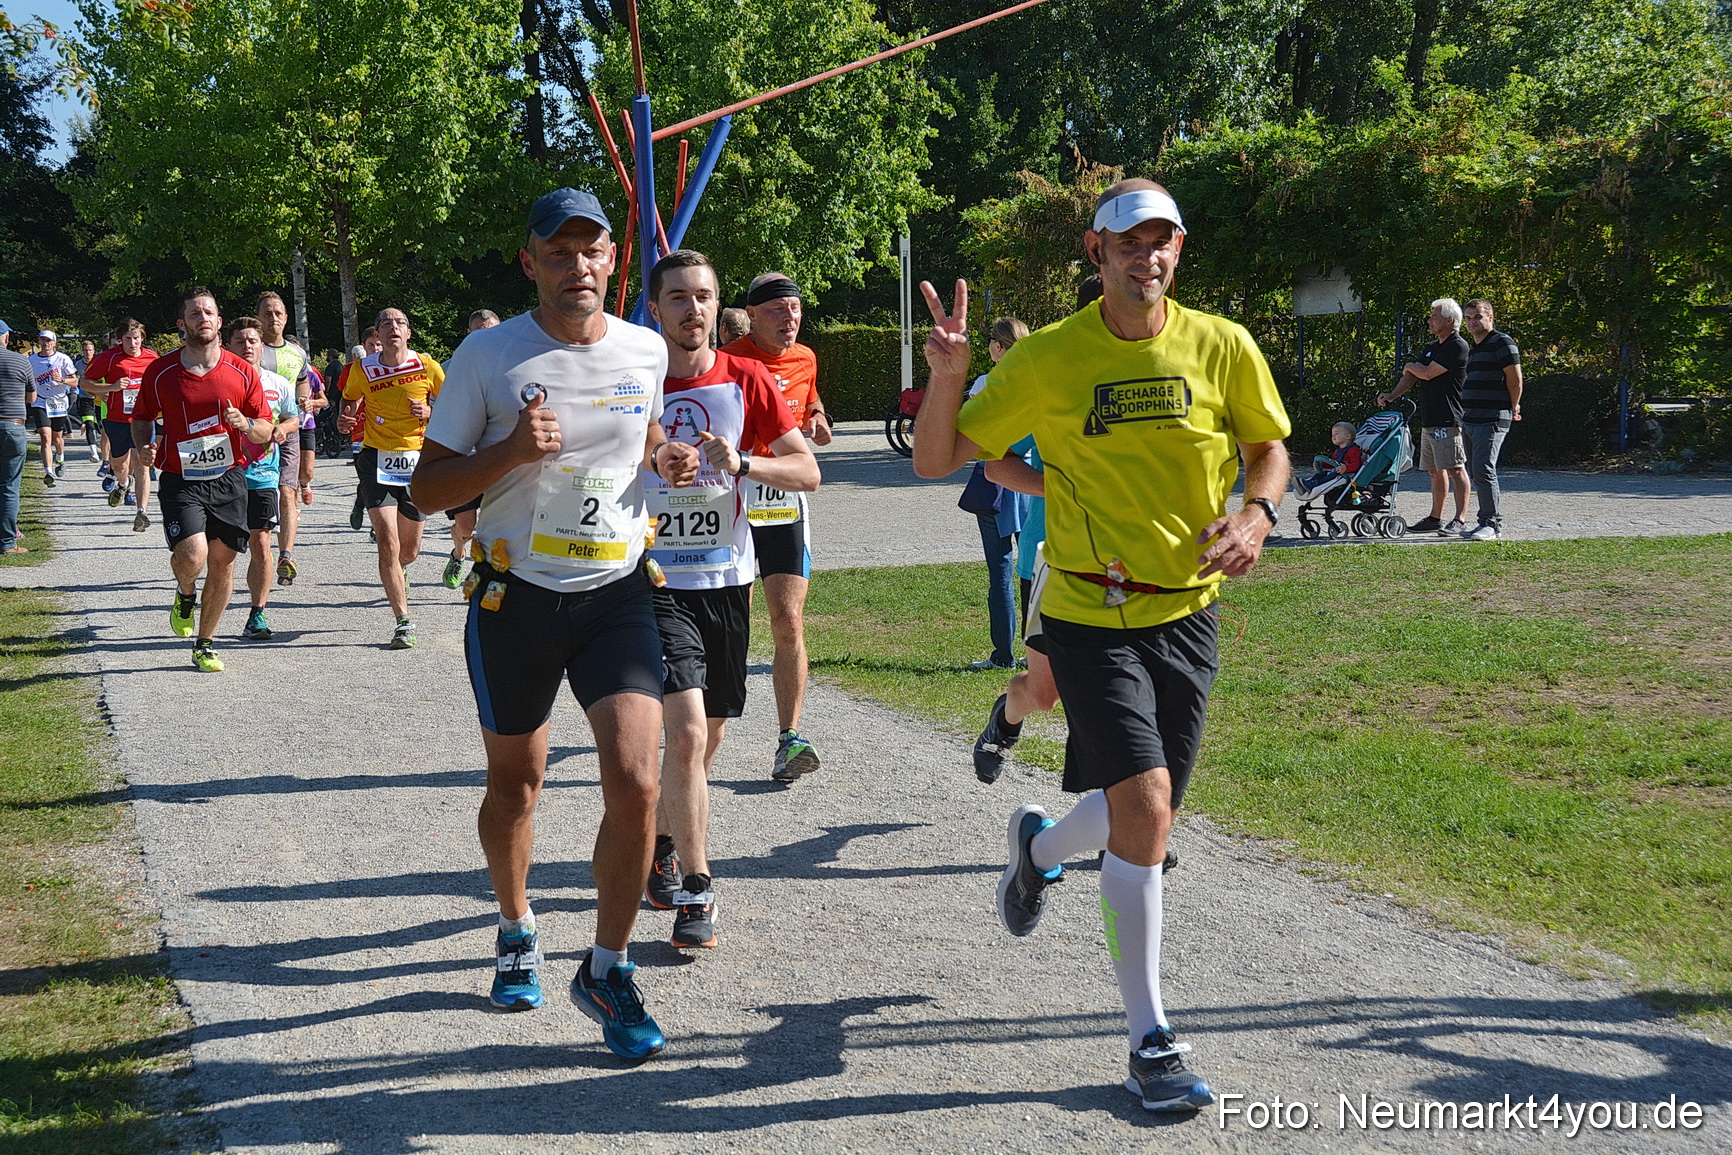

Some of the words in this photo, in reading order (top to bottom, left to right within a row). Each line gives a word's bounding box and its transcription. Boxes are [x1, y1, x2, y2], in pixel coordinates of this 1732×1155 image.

[370, 380, 395, 393] MAX
[1109, 385, 1174, 402] RECHARGE
[1101, 399, 1182, 416] ENDORPHINS
[189, 446, 225, 464] 2438
[384, 457, 416, 470] 2404
[572, 476, 614, 489] BOCK
[669, 495, 708, 505] BOCK
[580, 497, 600, 526] 2
[747, 511, 792, 520] Hans-Werner
[658, 511, 720, 537] 2129
[556, 527, 578, 536] PARTL
[568, 543, 600, 557] Peter
[672, 552, 706, 563] Jonas
